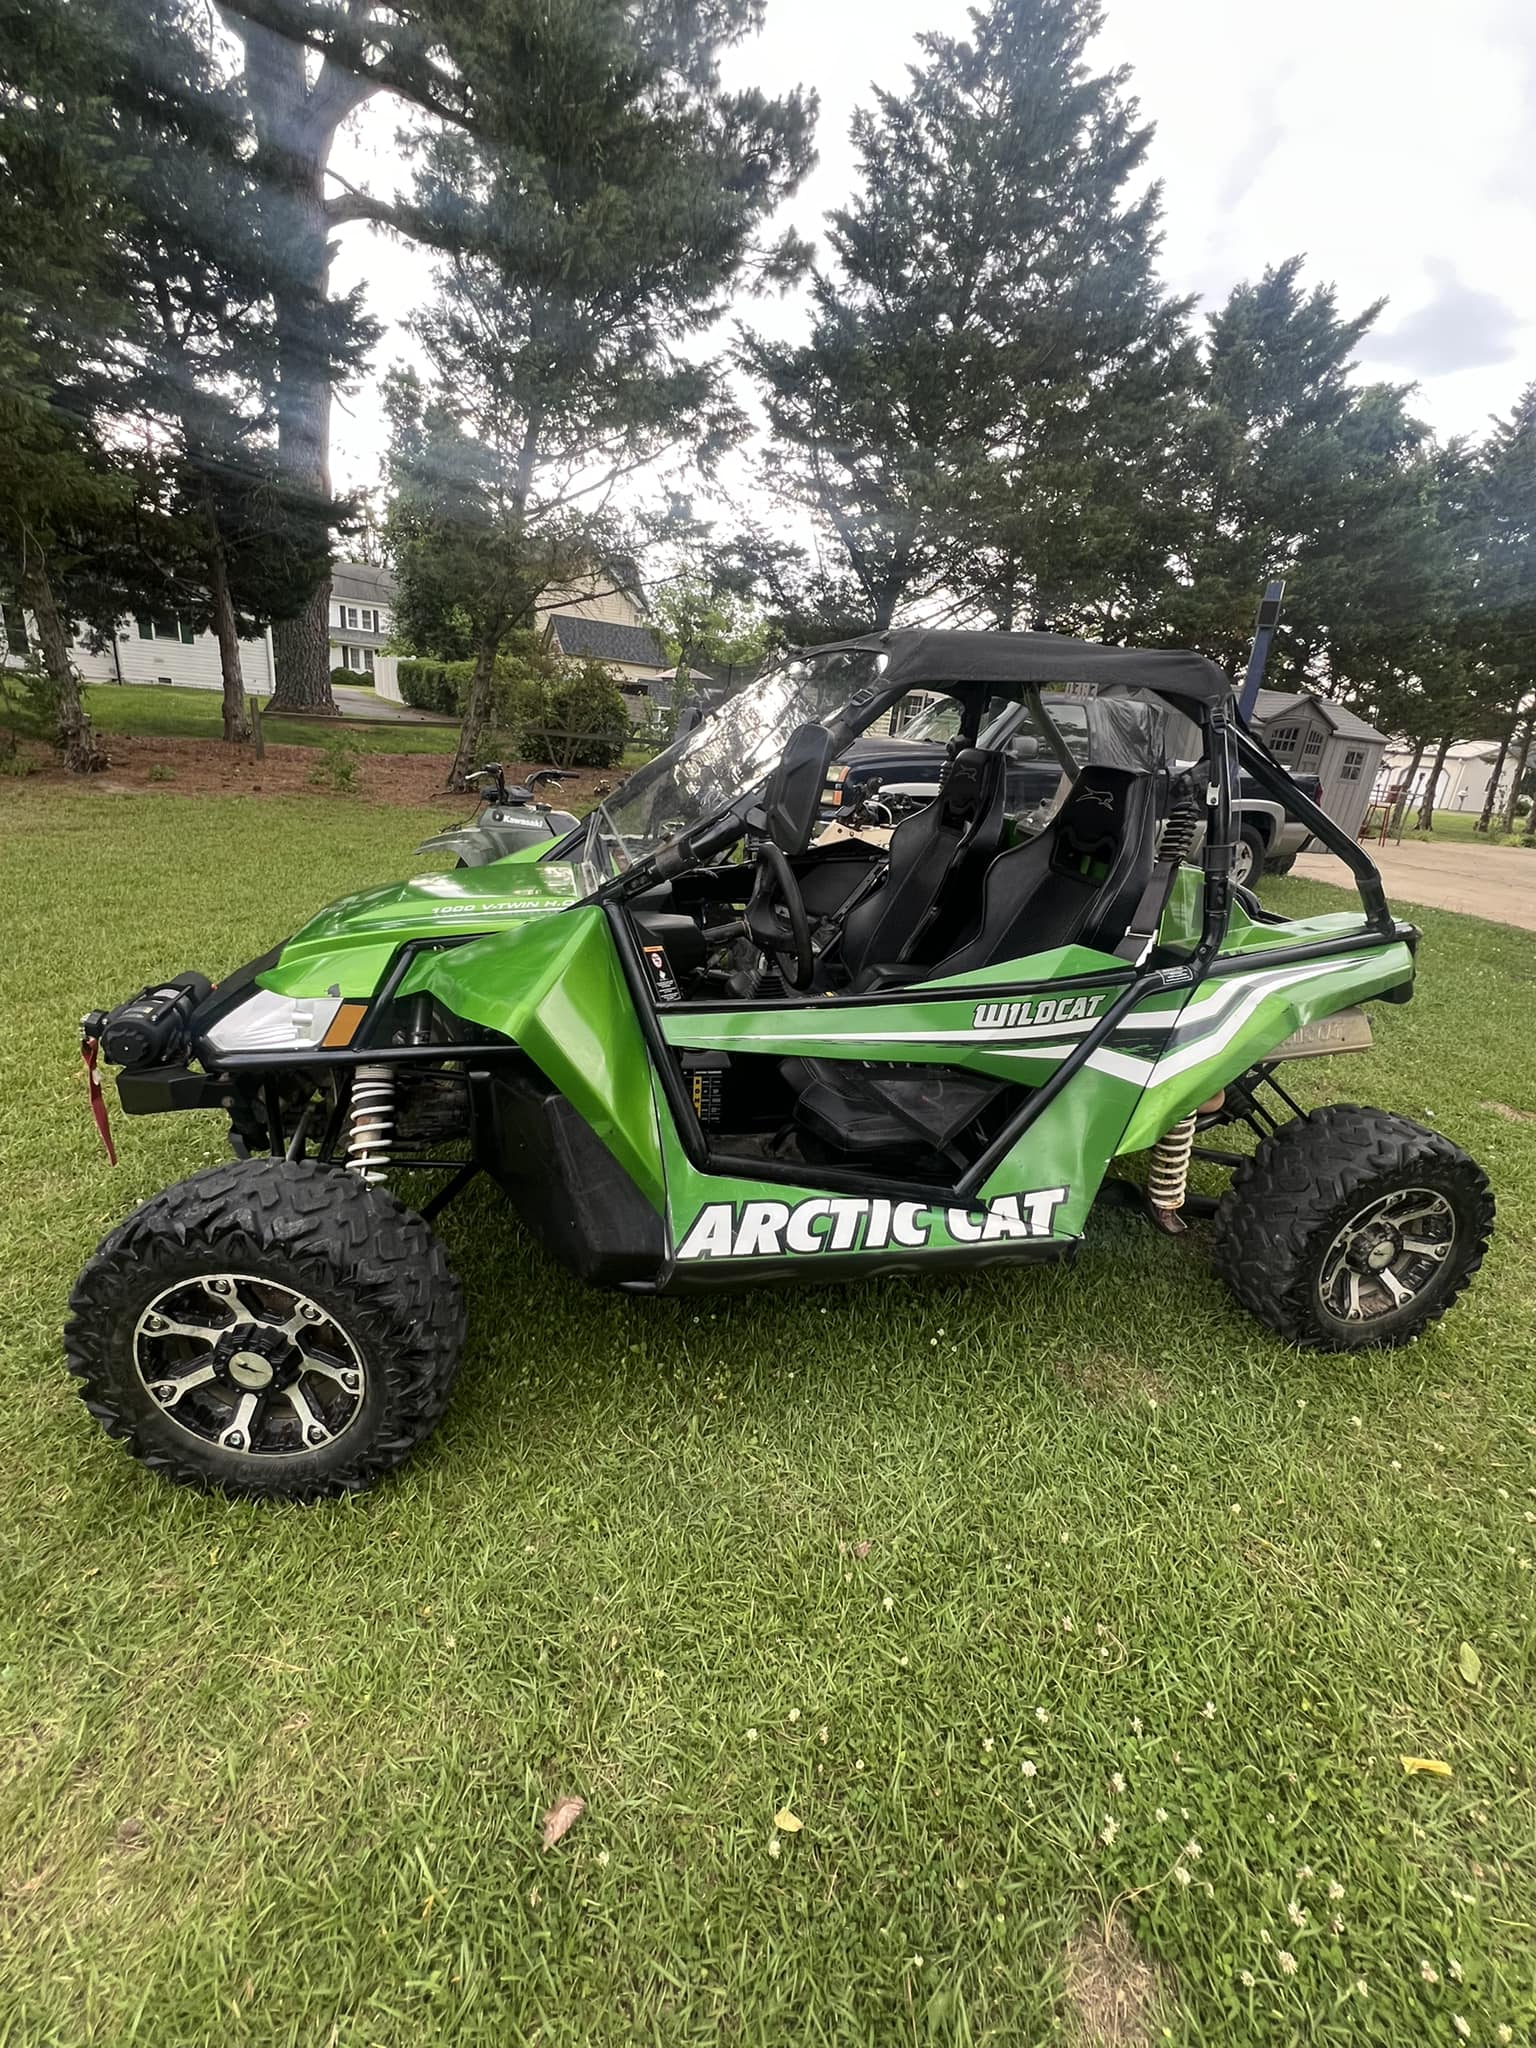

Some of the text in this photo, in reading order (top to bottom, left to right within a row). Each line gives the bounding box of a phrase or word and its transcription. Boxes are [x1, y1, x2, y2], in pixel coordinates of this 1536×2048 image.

[503, 815, 543, 828] Kawasaki
[433, 905, 476, 913] 1000
[482, 902, 540, 910] V-TWIN
[974, 995, 1106, 1029] WILDCAT
[677, 1186, 1070, 1261] ARCTIC CAT
